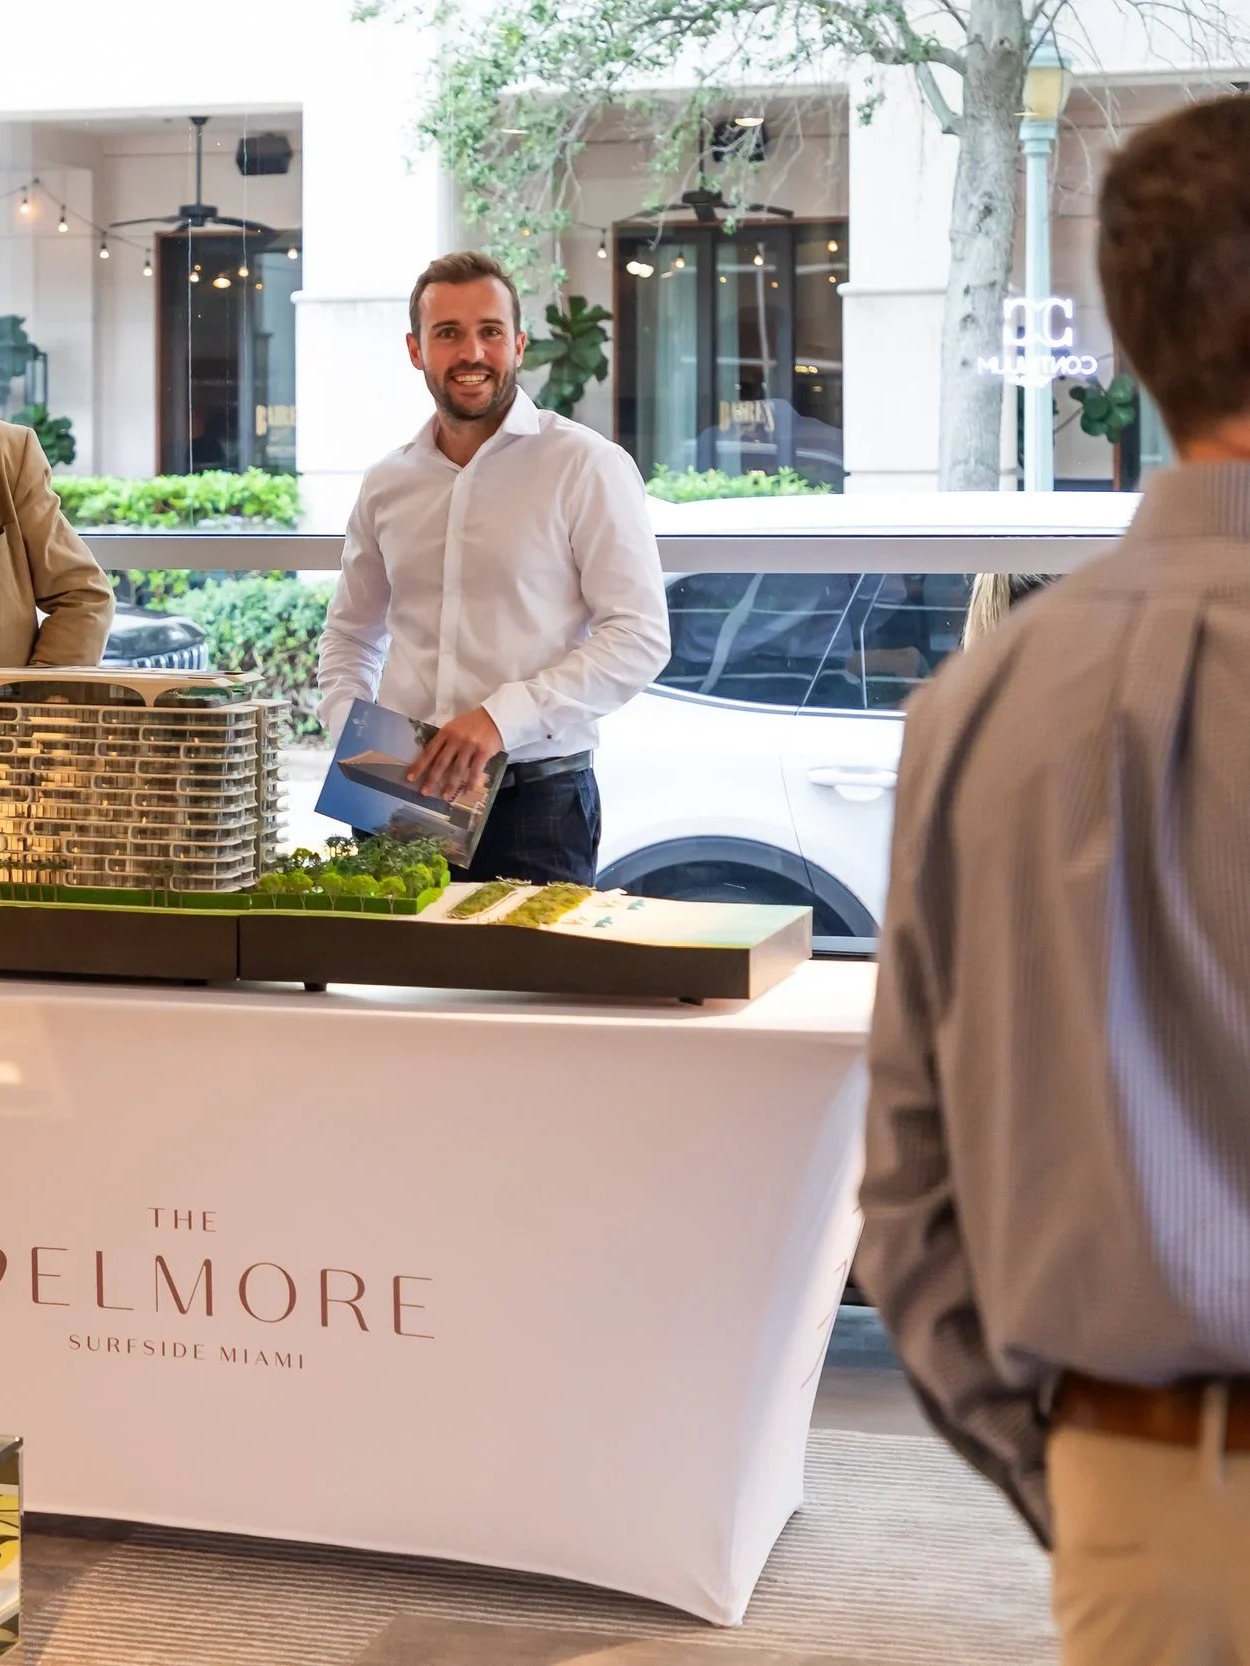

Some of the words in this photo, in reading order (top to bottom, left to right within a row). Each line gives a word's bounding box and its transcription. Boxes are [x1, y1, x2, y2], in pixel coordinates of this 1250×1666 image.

[148, 1207, 217, 1233] THE
[68, 1334, 205, 1360] SURFSIDE
[220, 1346, 304, 1369] MIAMI
